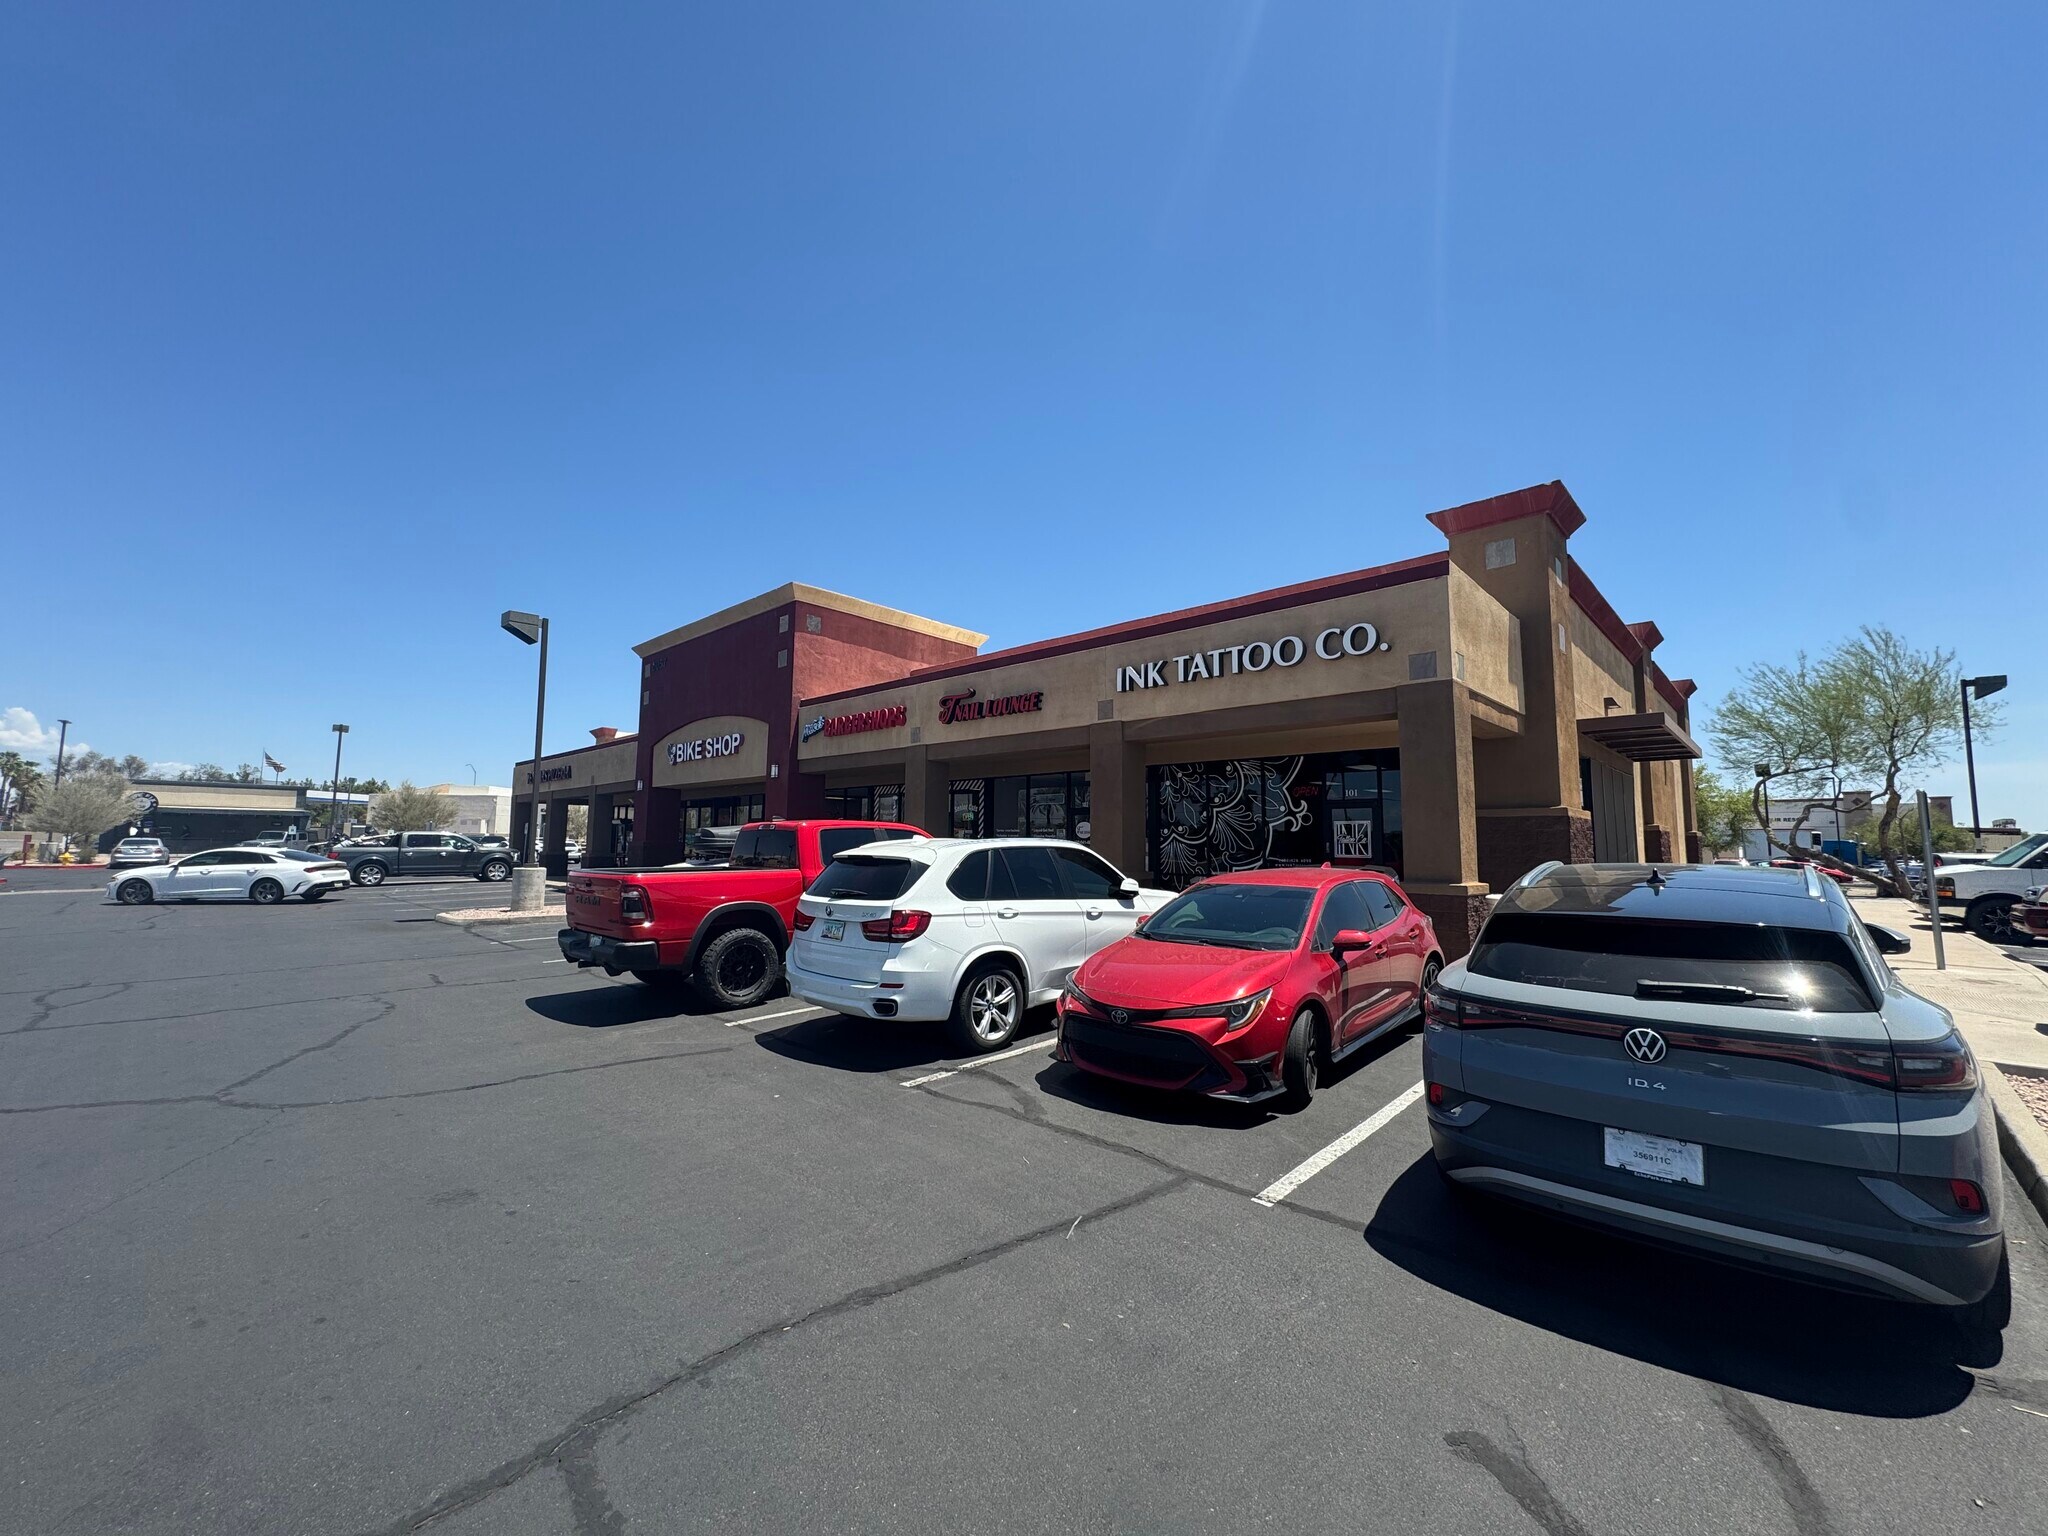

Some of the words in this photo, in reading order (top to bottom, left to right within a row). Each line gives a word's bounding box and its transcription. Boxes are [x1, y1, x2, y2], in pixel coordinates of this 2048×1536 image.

[1116, 660, 1166, 692] INK
[1173, 636, 1304, 682] TATTOO
[1315, 623, 1390, 660] CO.
[954, 702, 983, 722] NAIL
[984, 691, 1043, 717] LOUNGE
[824, 705, 907, 737] BARBERSHOPS
[676, 740, 703, 762] BIKE
[705, 733, 741, 758] SHOP
[1293, 786, 1319, 797] OPEN
[1345, 789, 1358, 797] 101
[576, 895, 600, 906] RAM
[1633, 1150, 1672, 1165] 356911C
